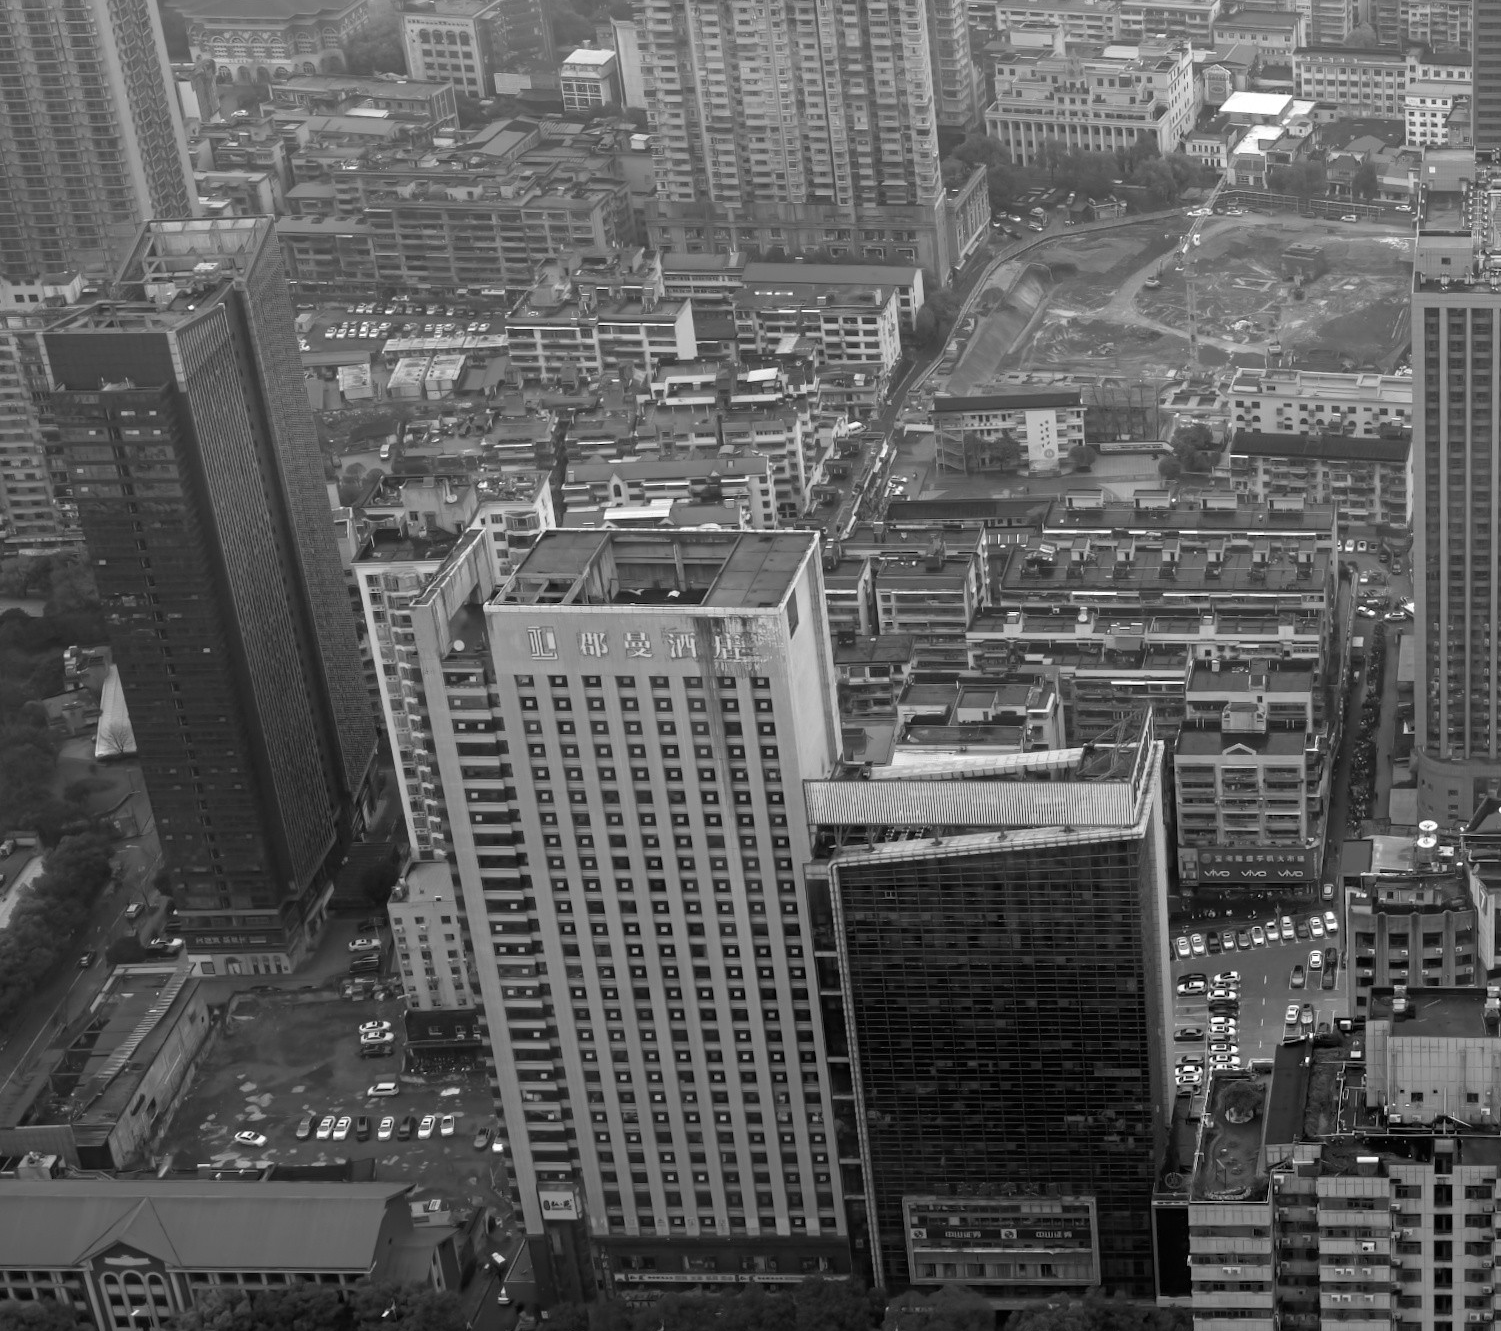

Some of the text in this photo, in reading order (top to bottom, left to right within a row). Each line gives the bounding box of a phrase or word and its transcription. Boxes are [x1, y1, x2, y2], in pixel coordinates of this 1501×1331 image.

[1204, 869, 1304, 877] vivo vivo vivo
